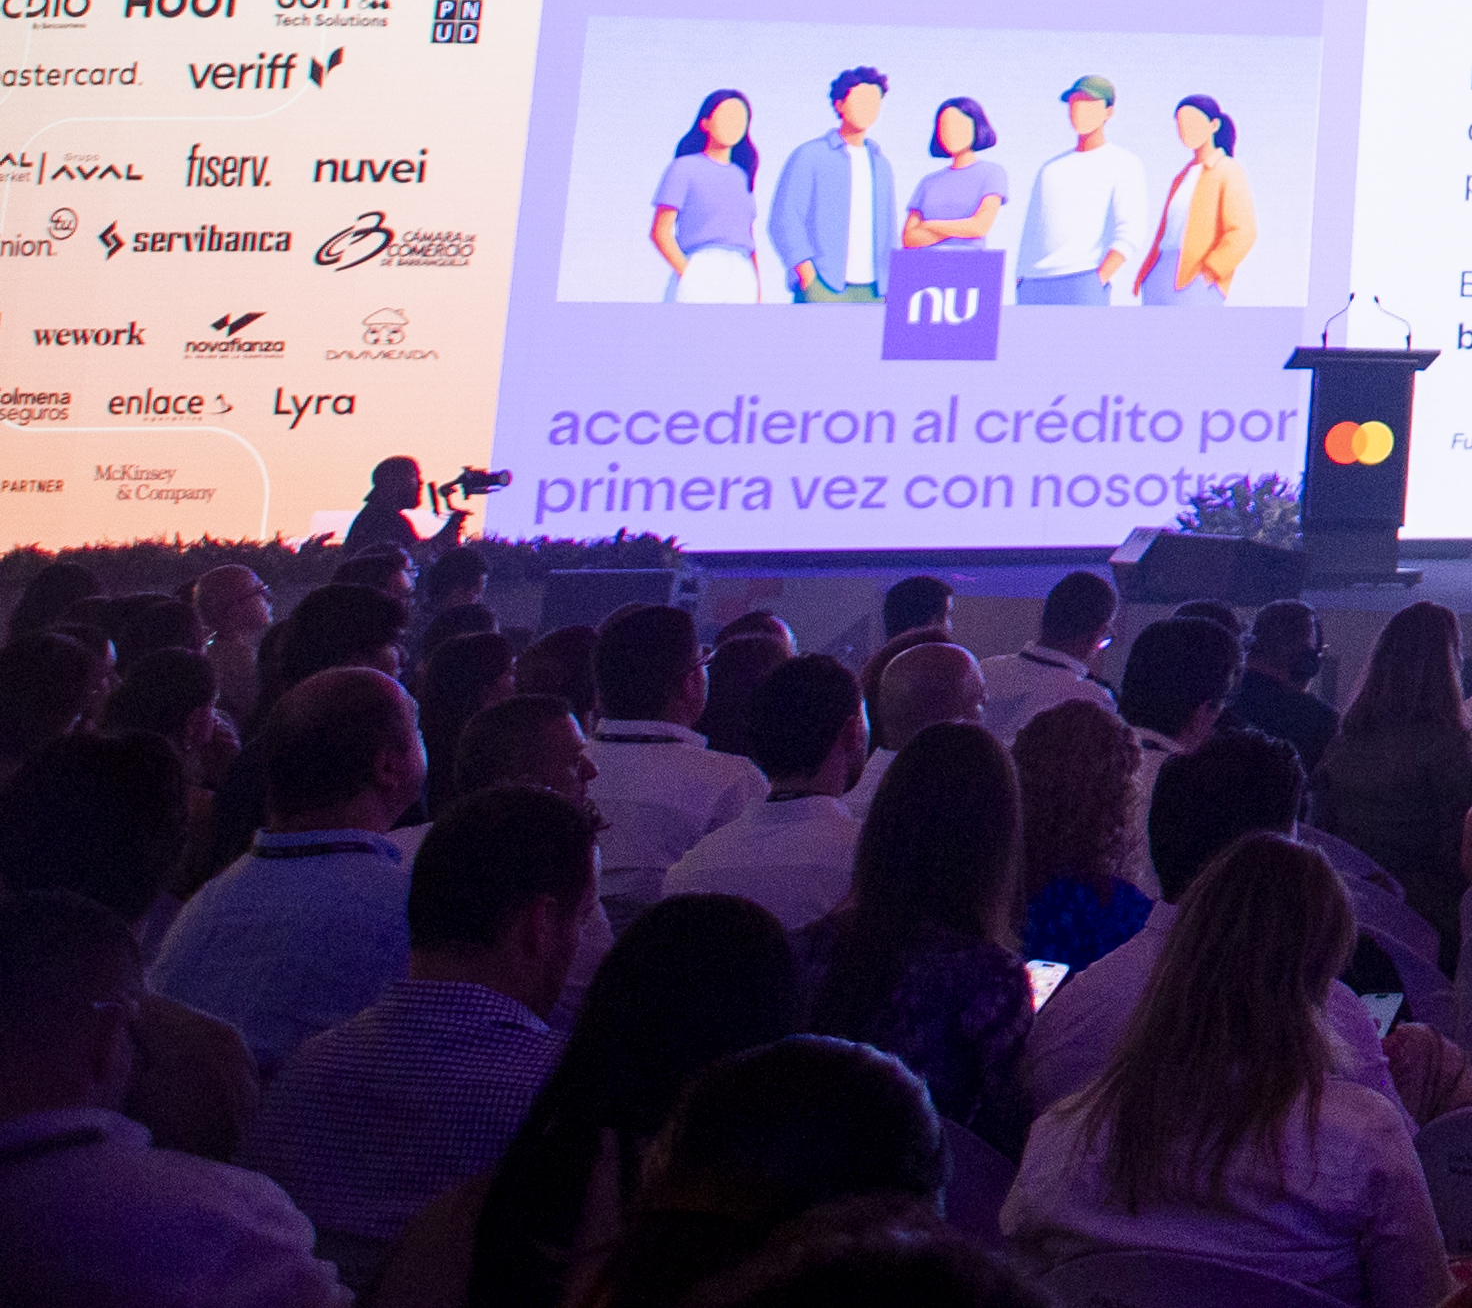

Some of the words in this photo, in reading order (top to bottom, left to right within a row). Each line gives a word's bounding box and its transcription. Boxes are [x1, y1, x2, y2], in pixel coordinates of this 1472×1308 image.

[189, 52, 297, 90] veriff
[313, 149, 428, 183] nuvei
[132, 225, 292, 252] servibanca
[34, 321, 145, 346] wework
[274, 387, 355, 430] Lyra
[547, 395, 895, 446] accedieron
[912, 395, 958, 444] al
[974, 395, 1183, 444] crédito
[1199, 409, 1298, 454] por
[534, 462, 772, 525] primera
[790, 475, 888, 510] vez
[904, 475, 1013, 510] con
[1030, 470, 1283, 510] nosotr
